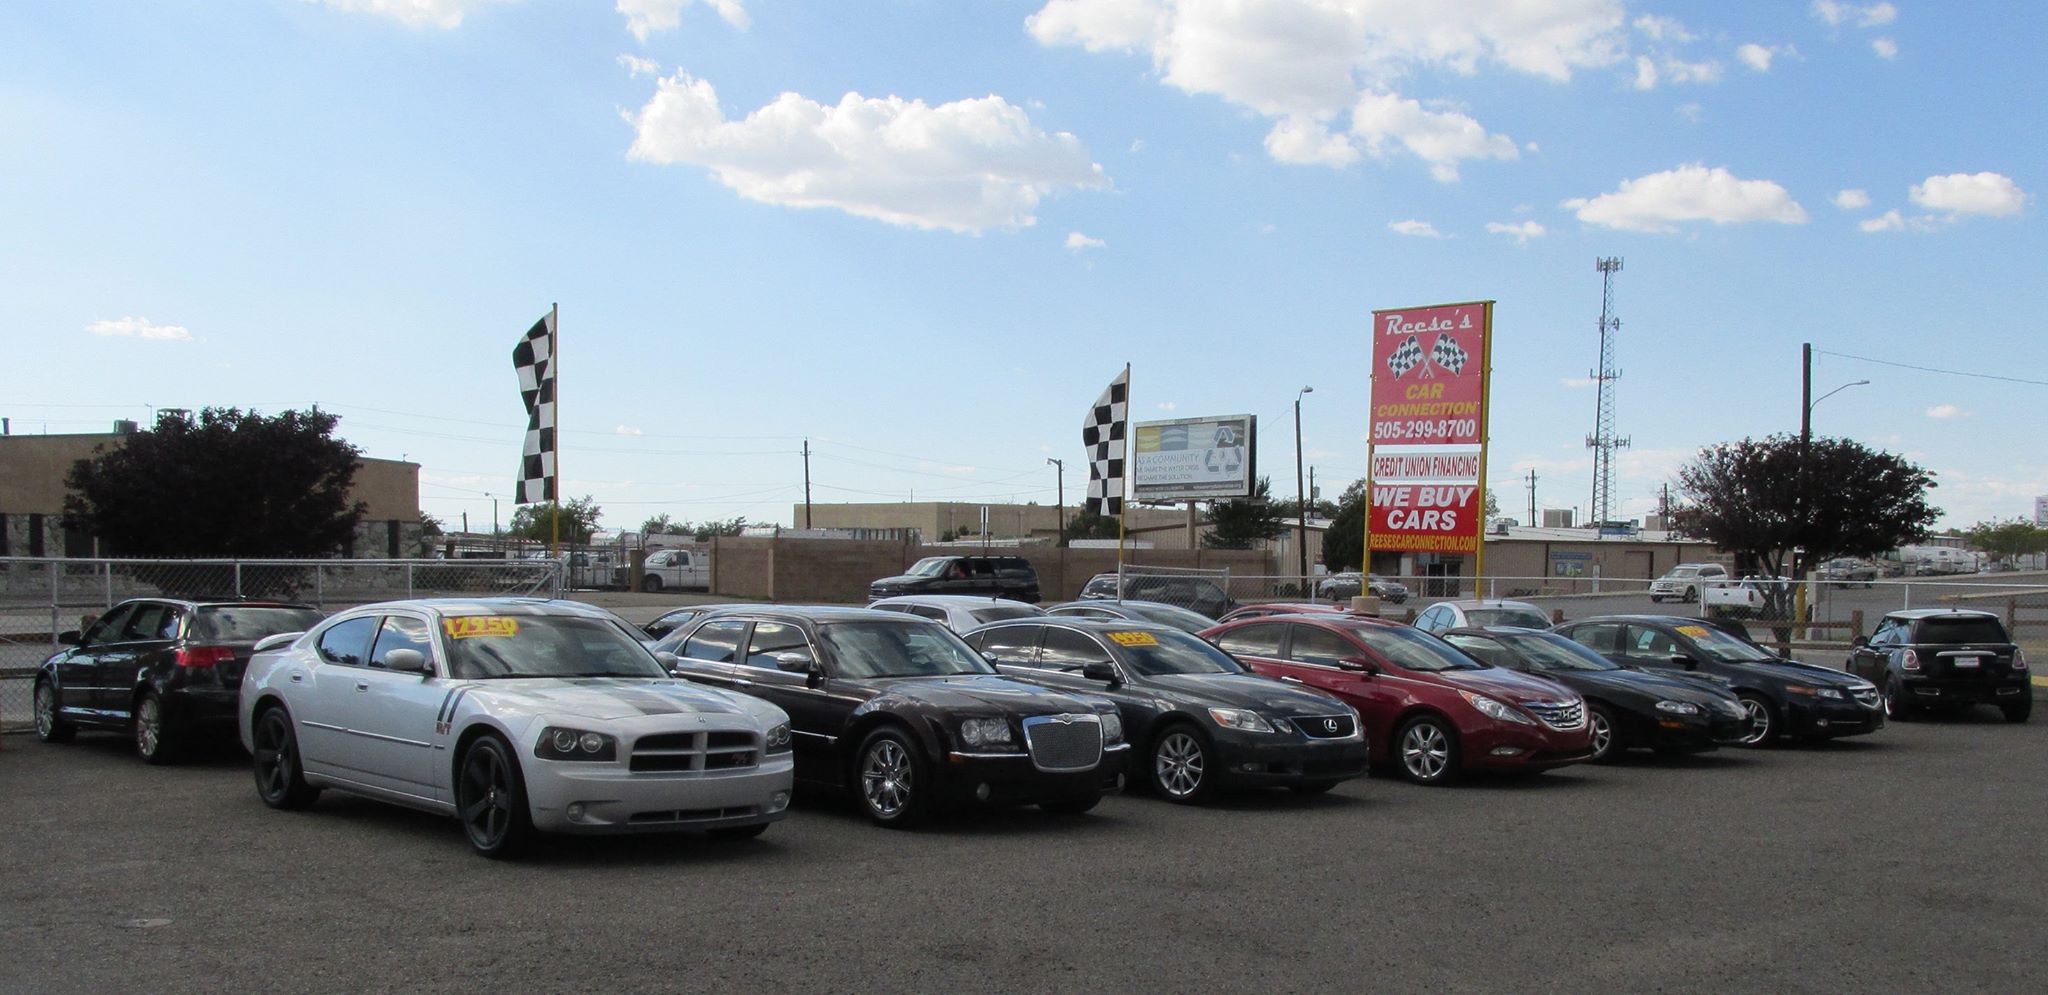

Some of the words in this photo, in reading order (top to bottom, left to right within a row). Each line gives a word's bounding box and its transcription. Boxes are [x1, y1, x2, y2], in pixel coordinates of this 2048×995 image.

[1385, 309, 1473, 336] Reese's
[1405, 383, 1445, 400] CAR
[1377, 401, 1478, 417] CONNECTION
[1374, 419, 1476, 439] 505-299-8700
[1152, 453, 1200, 464] COMMUNITY
[1374, 457, 1404, 477] CREDIT
[1405, 456, 1432, 477] UNION
[1433, 455, 1478, 477] FINANCING
[1373, 487, 1411, 507] WE
[1417, 487, 1475, 507] BUY
[1387, 509, 1457, 531] CARS
[1369, 534, 1477, 551] REESESCARCONNECTION.COM
